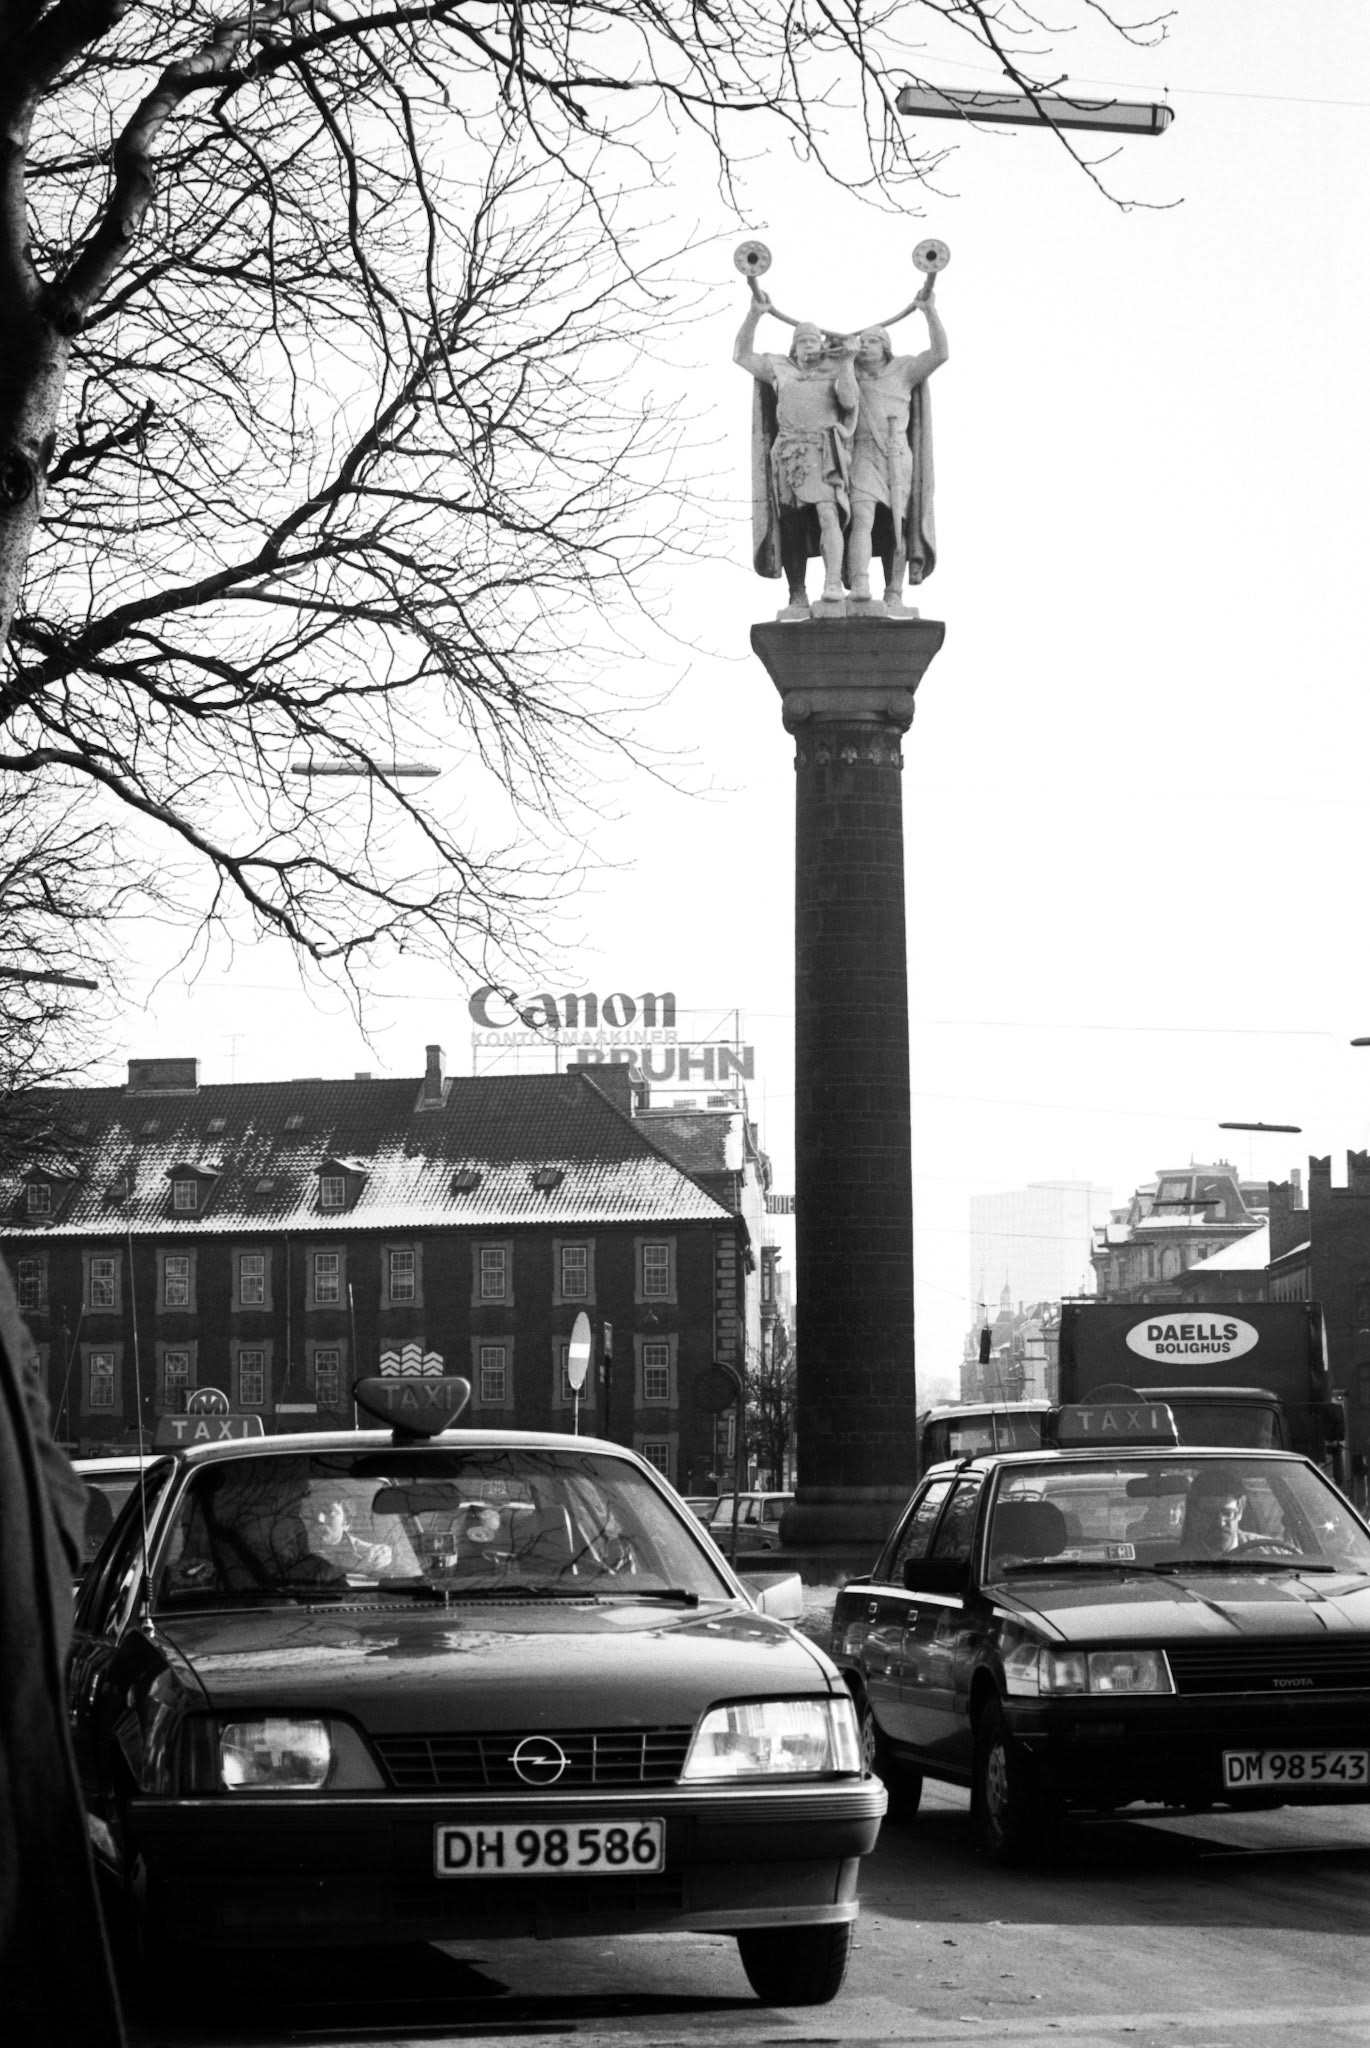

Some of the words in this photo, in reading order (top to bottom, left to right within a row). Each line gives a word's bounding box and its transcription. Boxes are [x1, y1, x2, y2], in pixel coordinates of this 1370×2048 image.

[467, 984, 676, 1029] Canon
[1147, 1323, 1239, 1342] DAELLS
[1155, 1342, 1231, 1354] BOLIGHUS
[380, 1384, 453, 1410] TAXI
[1076, 1410, 1158, 1430] TAXI
[171, 1421, 249, 1440] TAXI
[1272, 1678, 1314, 1687] TOYOTA
